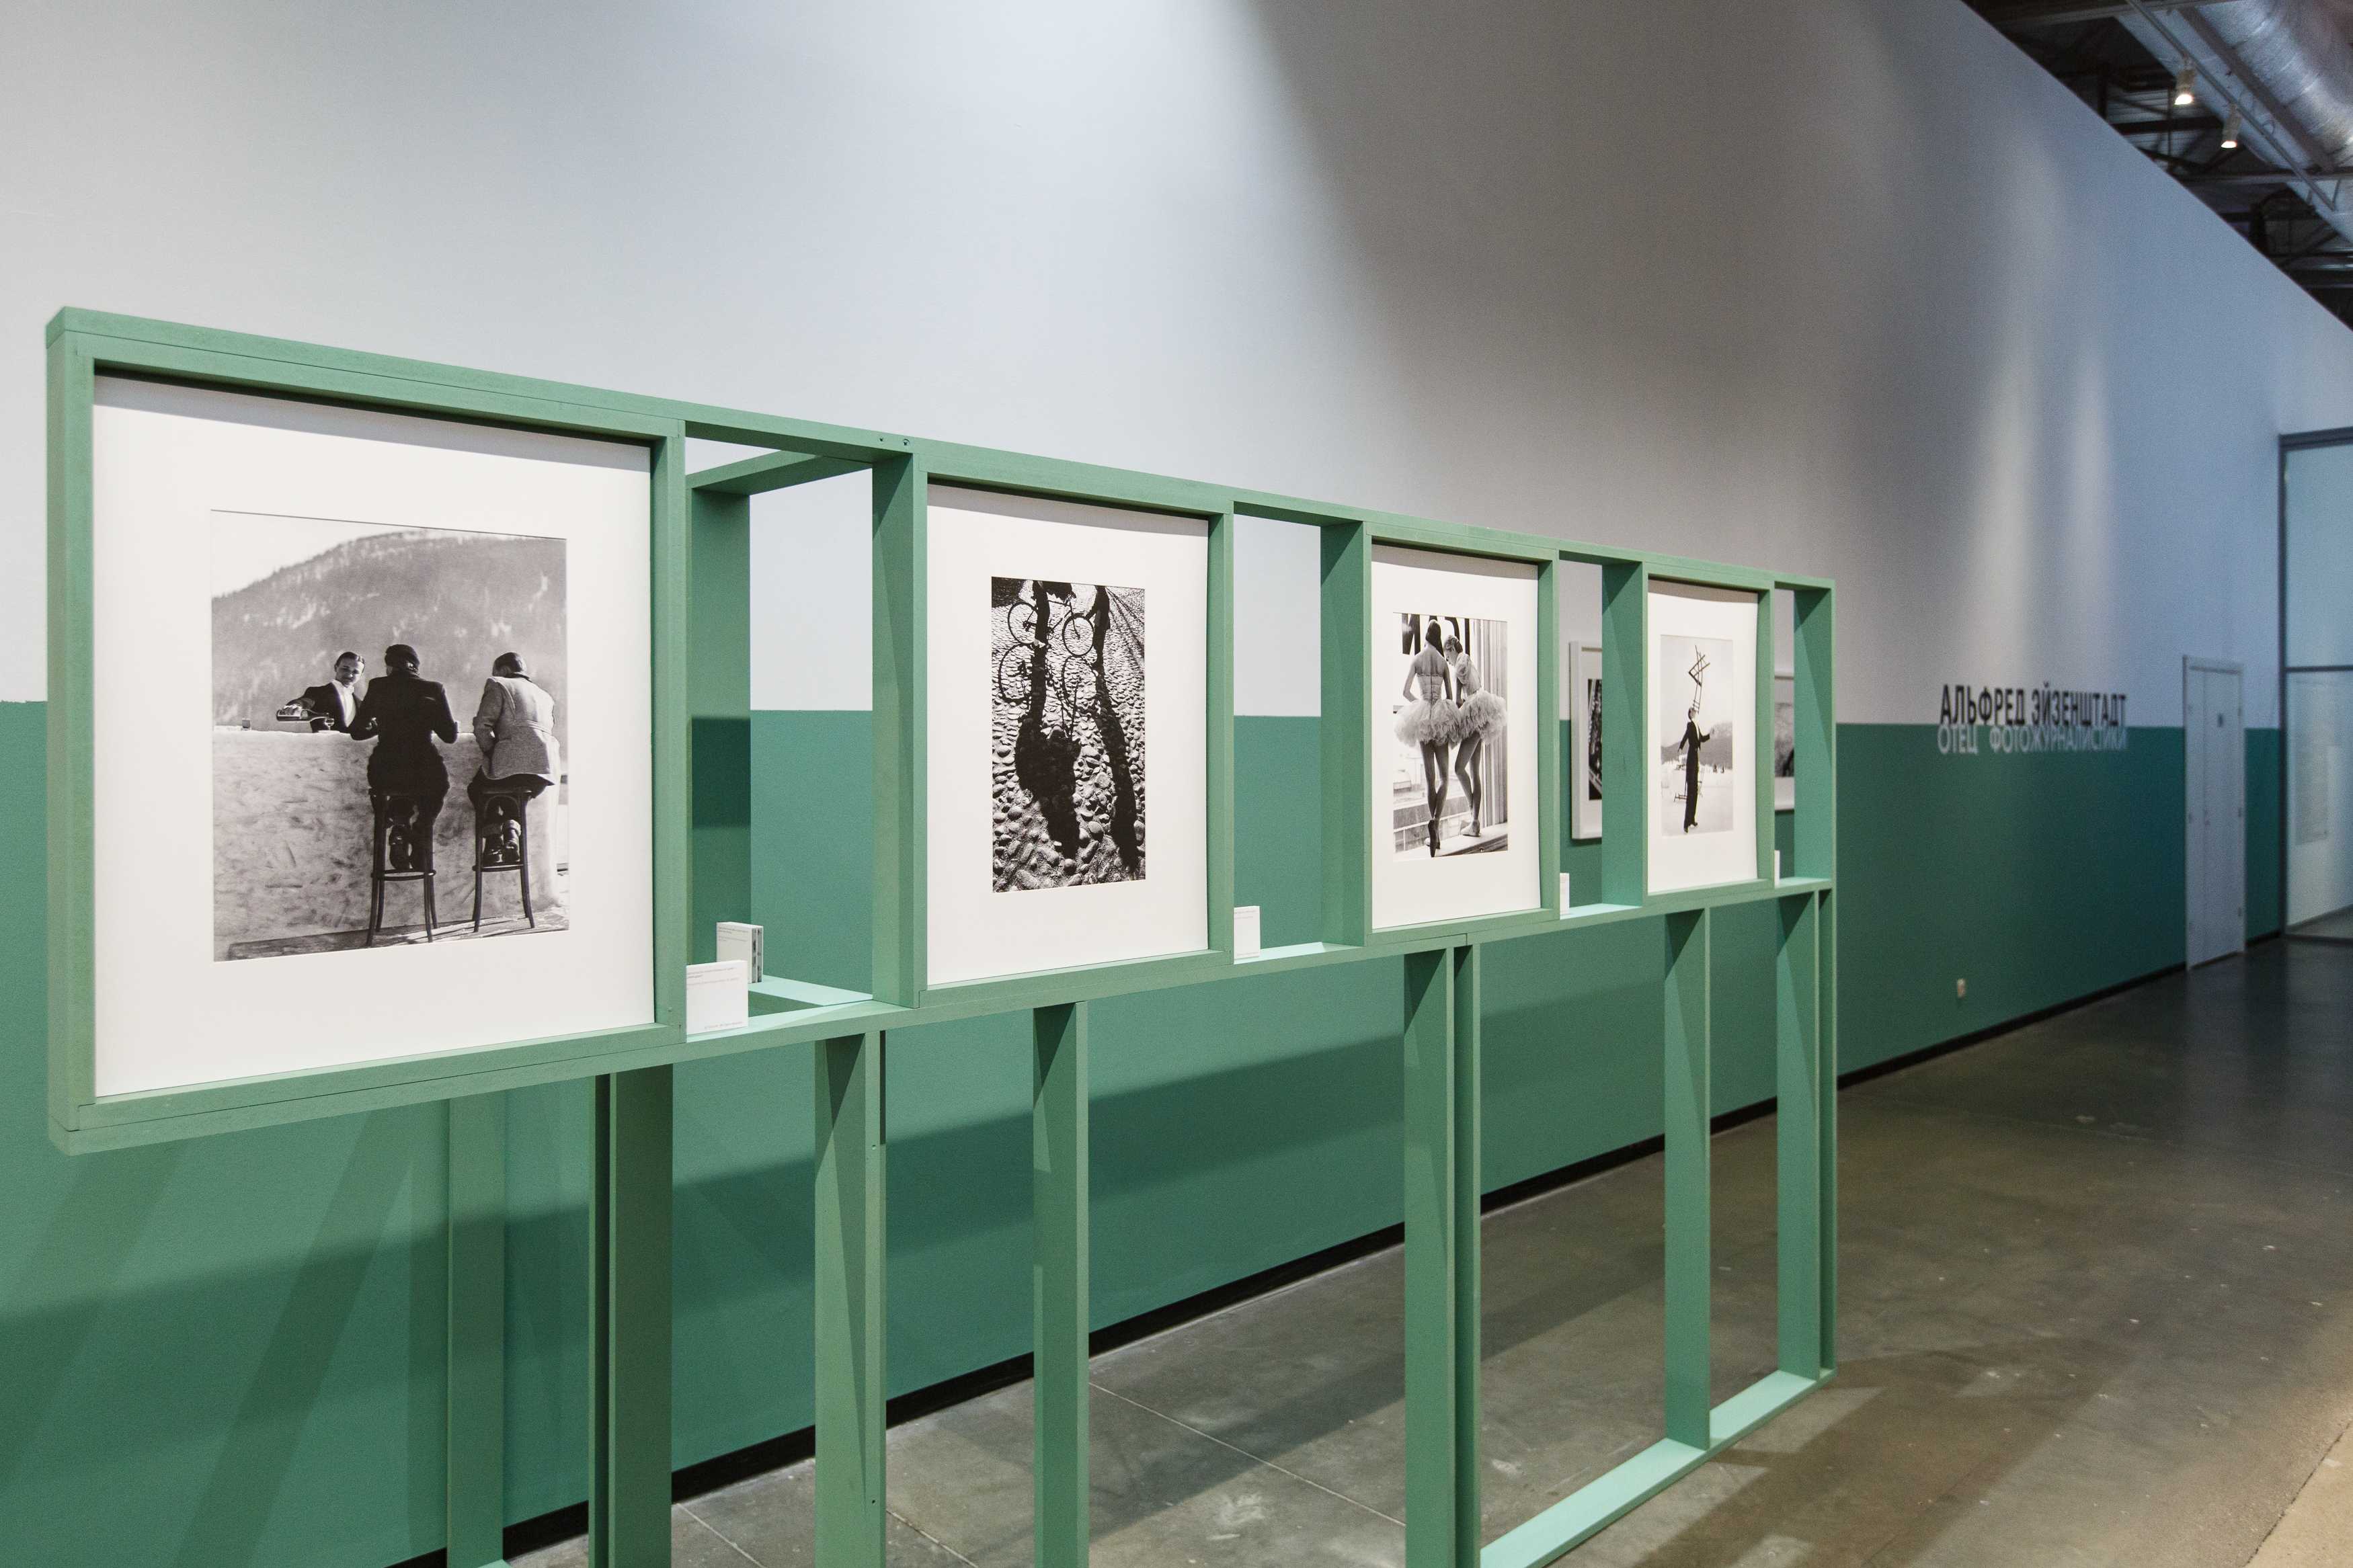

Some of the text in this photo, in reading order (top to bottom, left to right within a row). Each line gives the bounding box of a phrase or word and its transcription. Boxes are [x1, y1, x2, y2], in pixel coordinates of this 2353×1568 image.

[1940, 681, 2126, 727] АЛЬФРЕД ЭЙЗЕНШТАДТ
[1937, 724, 1979, 755] ОТЕЦ
